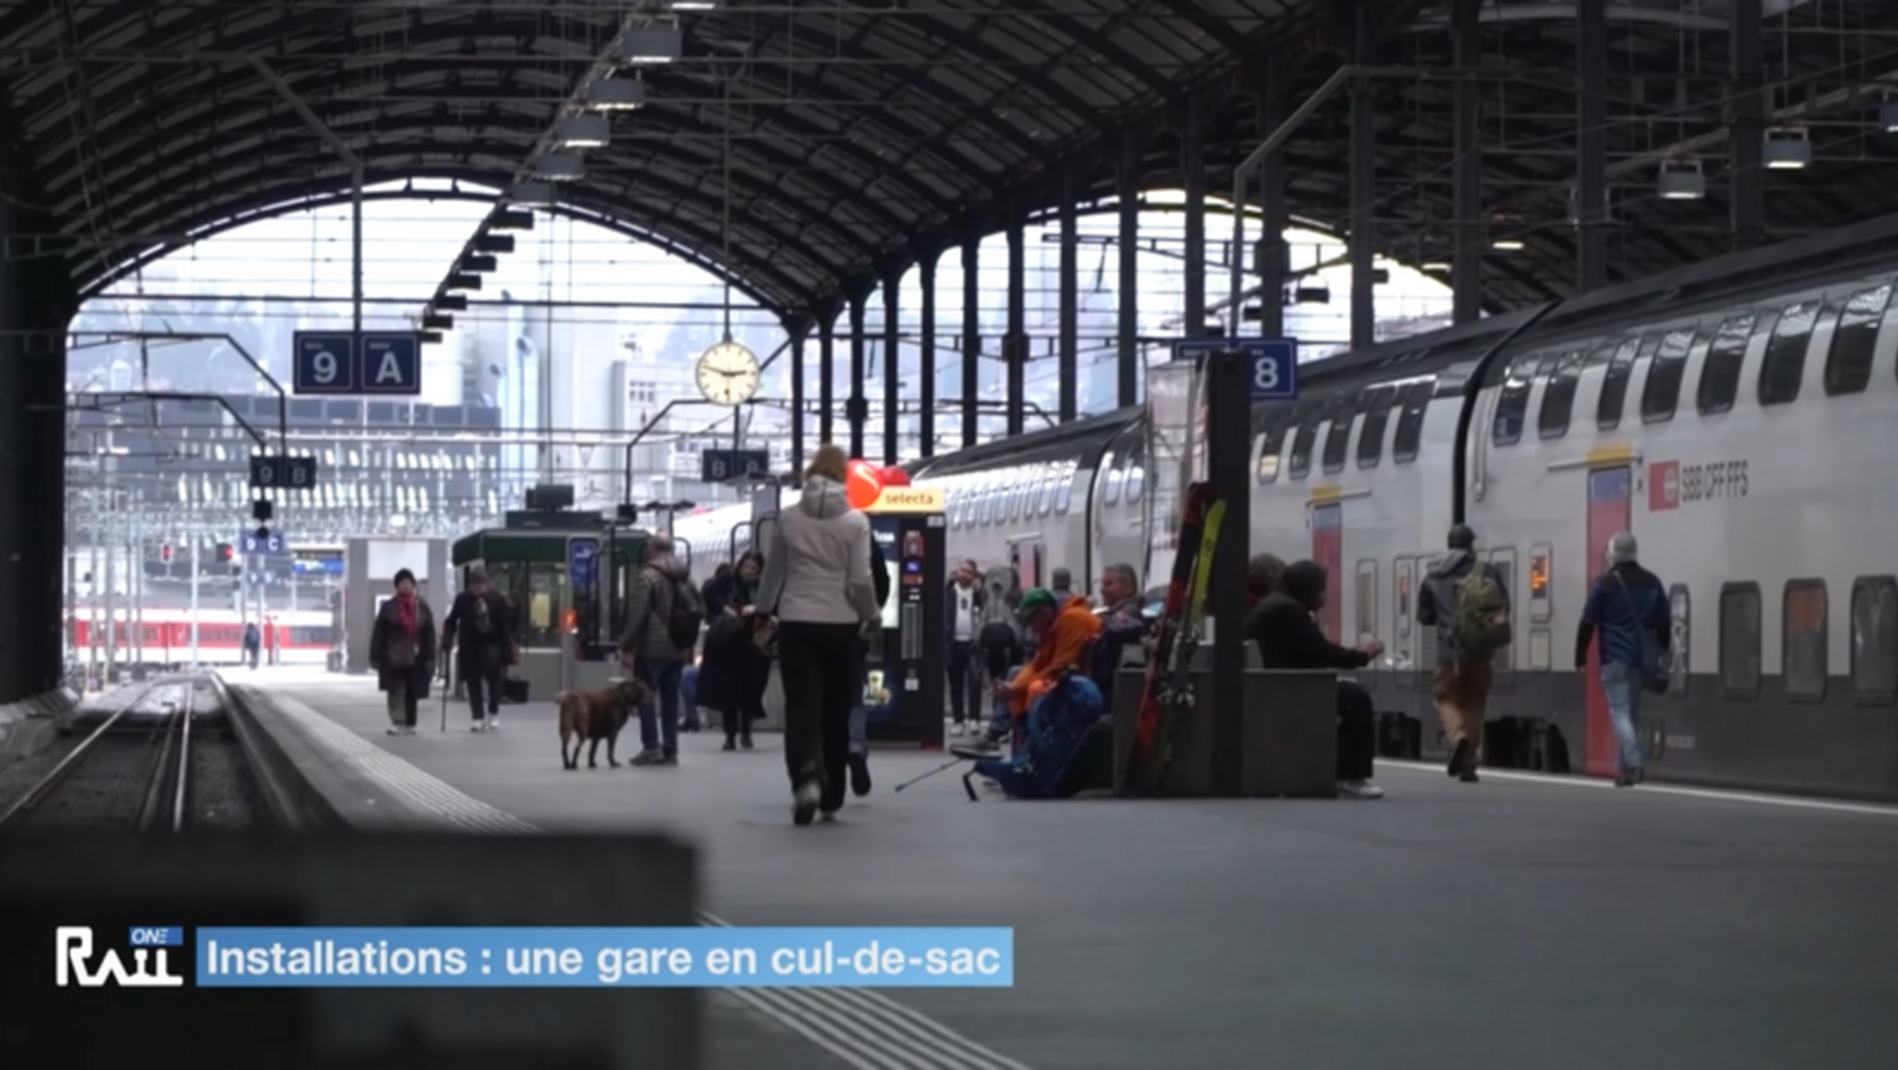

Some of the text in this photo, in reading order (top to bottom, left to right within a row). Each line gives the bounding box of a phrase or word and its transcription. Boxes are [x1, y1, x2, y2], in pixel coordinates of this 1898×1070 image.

[313, 351, 402, 383] 9 A
[1254, 357, 1279, 389] 8
[260, 466, 306, 484] 9 B
[711, 460, 726, 477] B
[1682, 459, 1749, 502] SBB CFF FFS
[885, 491, 934, 505] selecta
[267, 537, 279, 551] C
